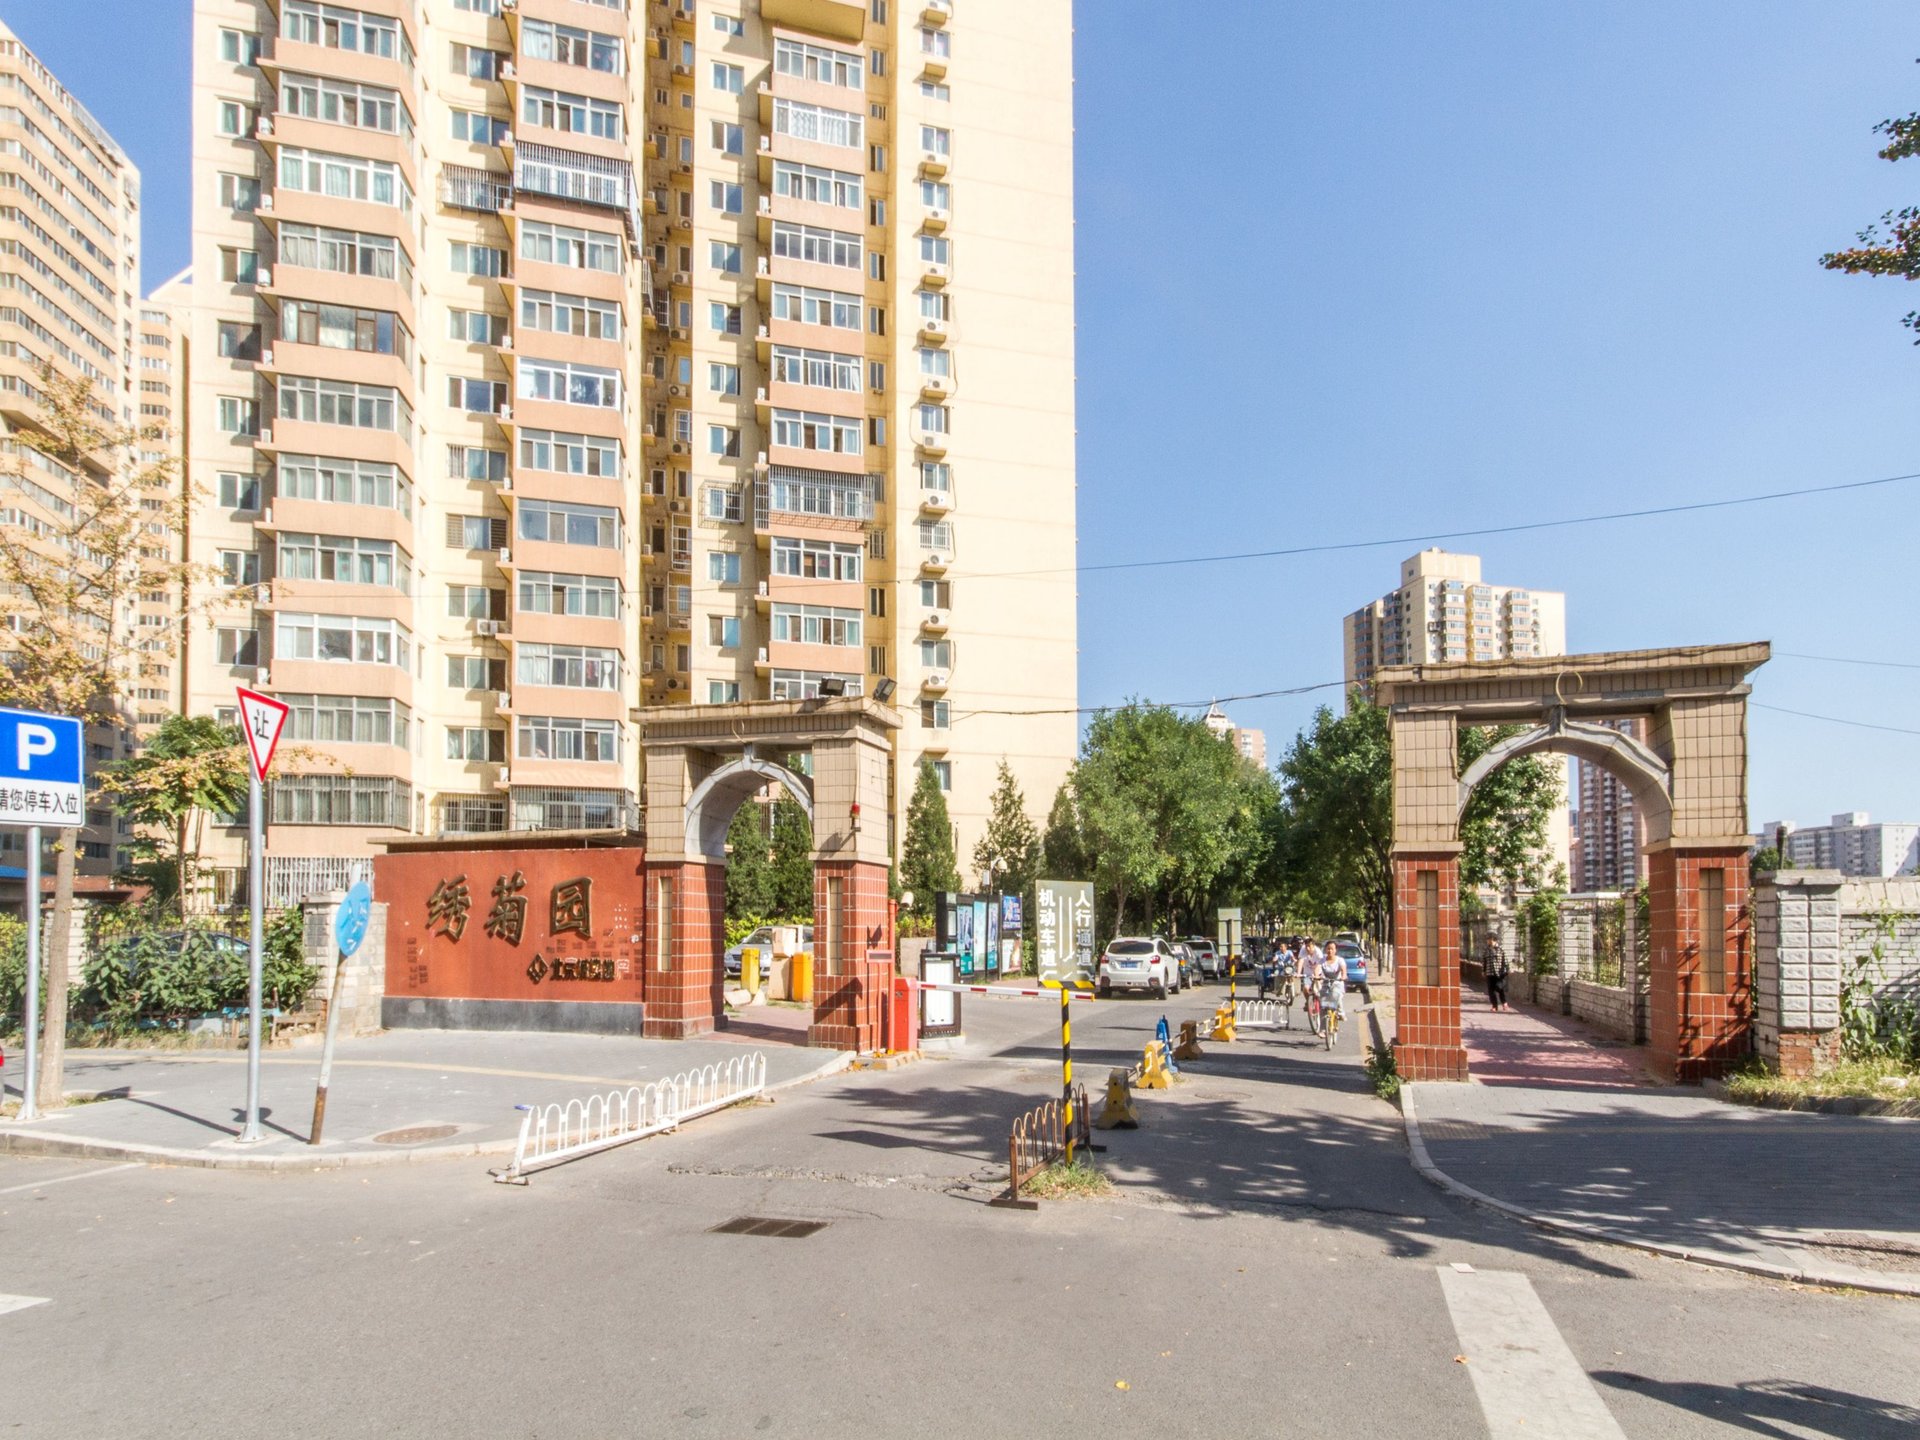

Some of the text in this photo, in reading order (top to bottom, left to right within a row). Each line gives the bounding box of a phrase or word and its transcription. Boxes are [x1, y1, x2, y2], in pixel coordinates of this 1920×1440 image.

[17, 722, 57, 771] P
[253, 708, 270, 740] 让
[424, 869, 593, 947] 绣菊园
[1038, 888, 1057, 967] 机动车道
[1075, 889, 1093, 967] 人行通道
